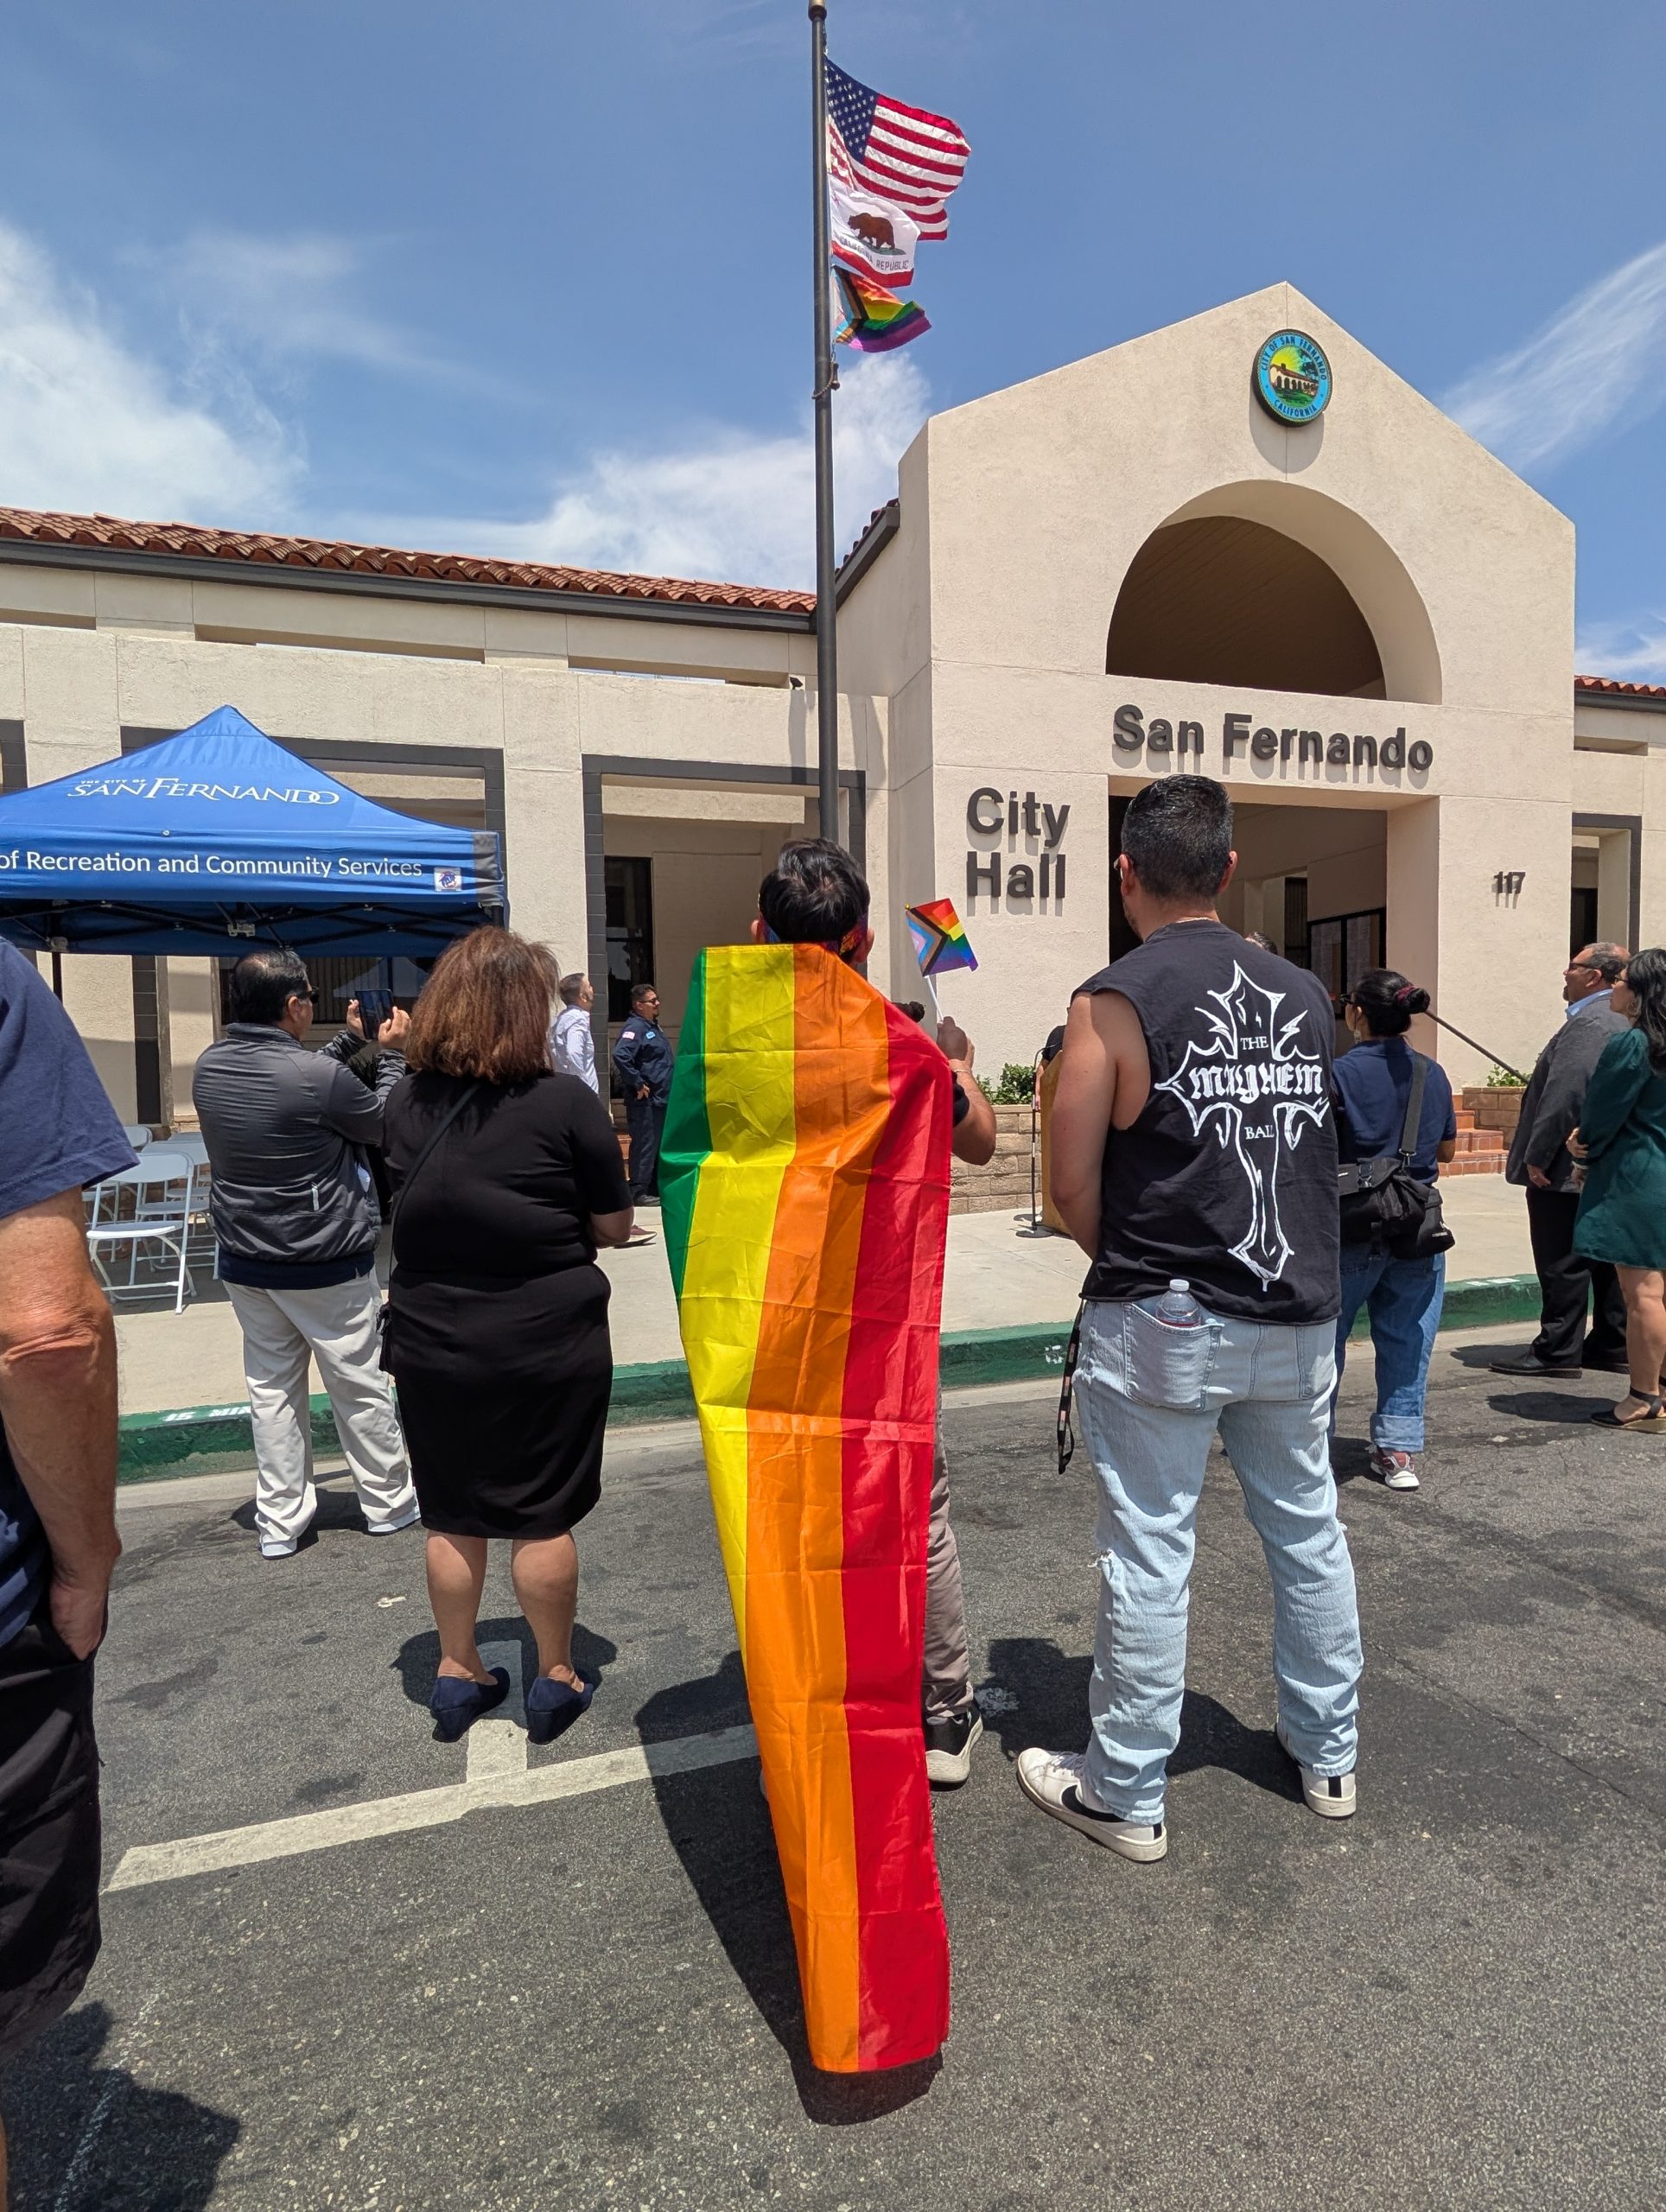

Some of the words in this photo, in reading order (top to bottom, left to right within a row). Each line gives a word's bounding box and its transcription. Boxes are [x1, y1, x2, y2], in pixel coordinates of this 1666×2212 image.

[839, 236, 873, 263] CALIFORNIA
[876, 260, 909, 270] REPUBLIC
[1262, 353, 1271, 371] CITY
[1269, 341, 1279, 352] OF
[1280, 336, 1295, 346] SAN
[1300, 339, 1326, 380] FERNANDO
[1275, 400, 1318, 416] CALIFORNIA
[1113, 703, 1204, 753] San
[1223, 713, 1434, 771] Fernando
[67, 783, 148, 797] SAN
[143, 778, 340, 805] FERNANDO
[968, 787, 1071, 848] City
[0, 850, 19, 869] of
[27, 852, 150, 871] Recreation
[158, 855, 199, 873] and
[207, 855, 332, 878] Community
[339, 857, 422, 876] Services
[967, 851, 1065, 899] Hall
[1493, 871, 1526, 894] 117
[1240, 1036, 1269, 1050] THE
[165, 1411, 197, 1421] 15
